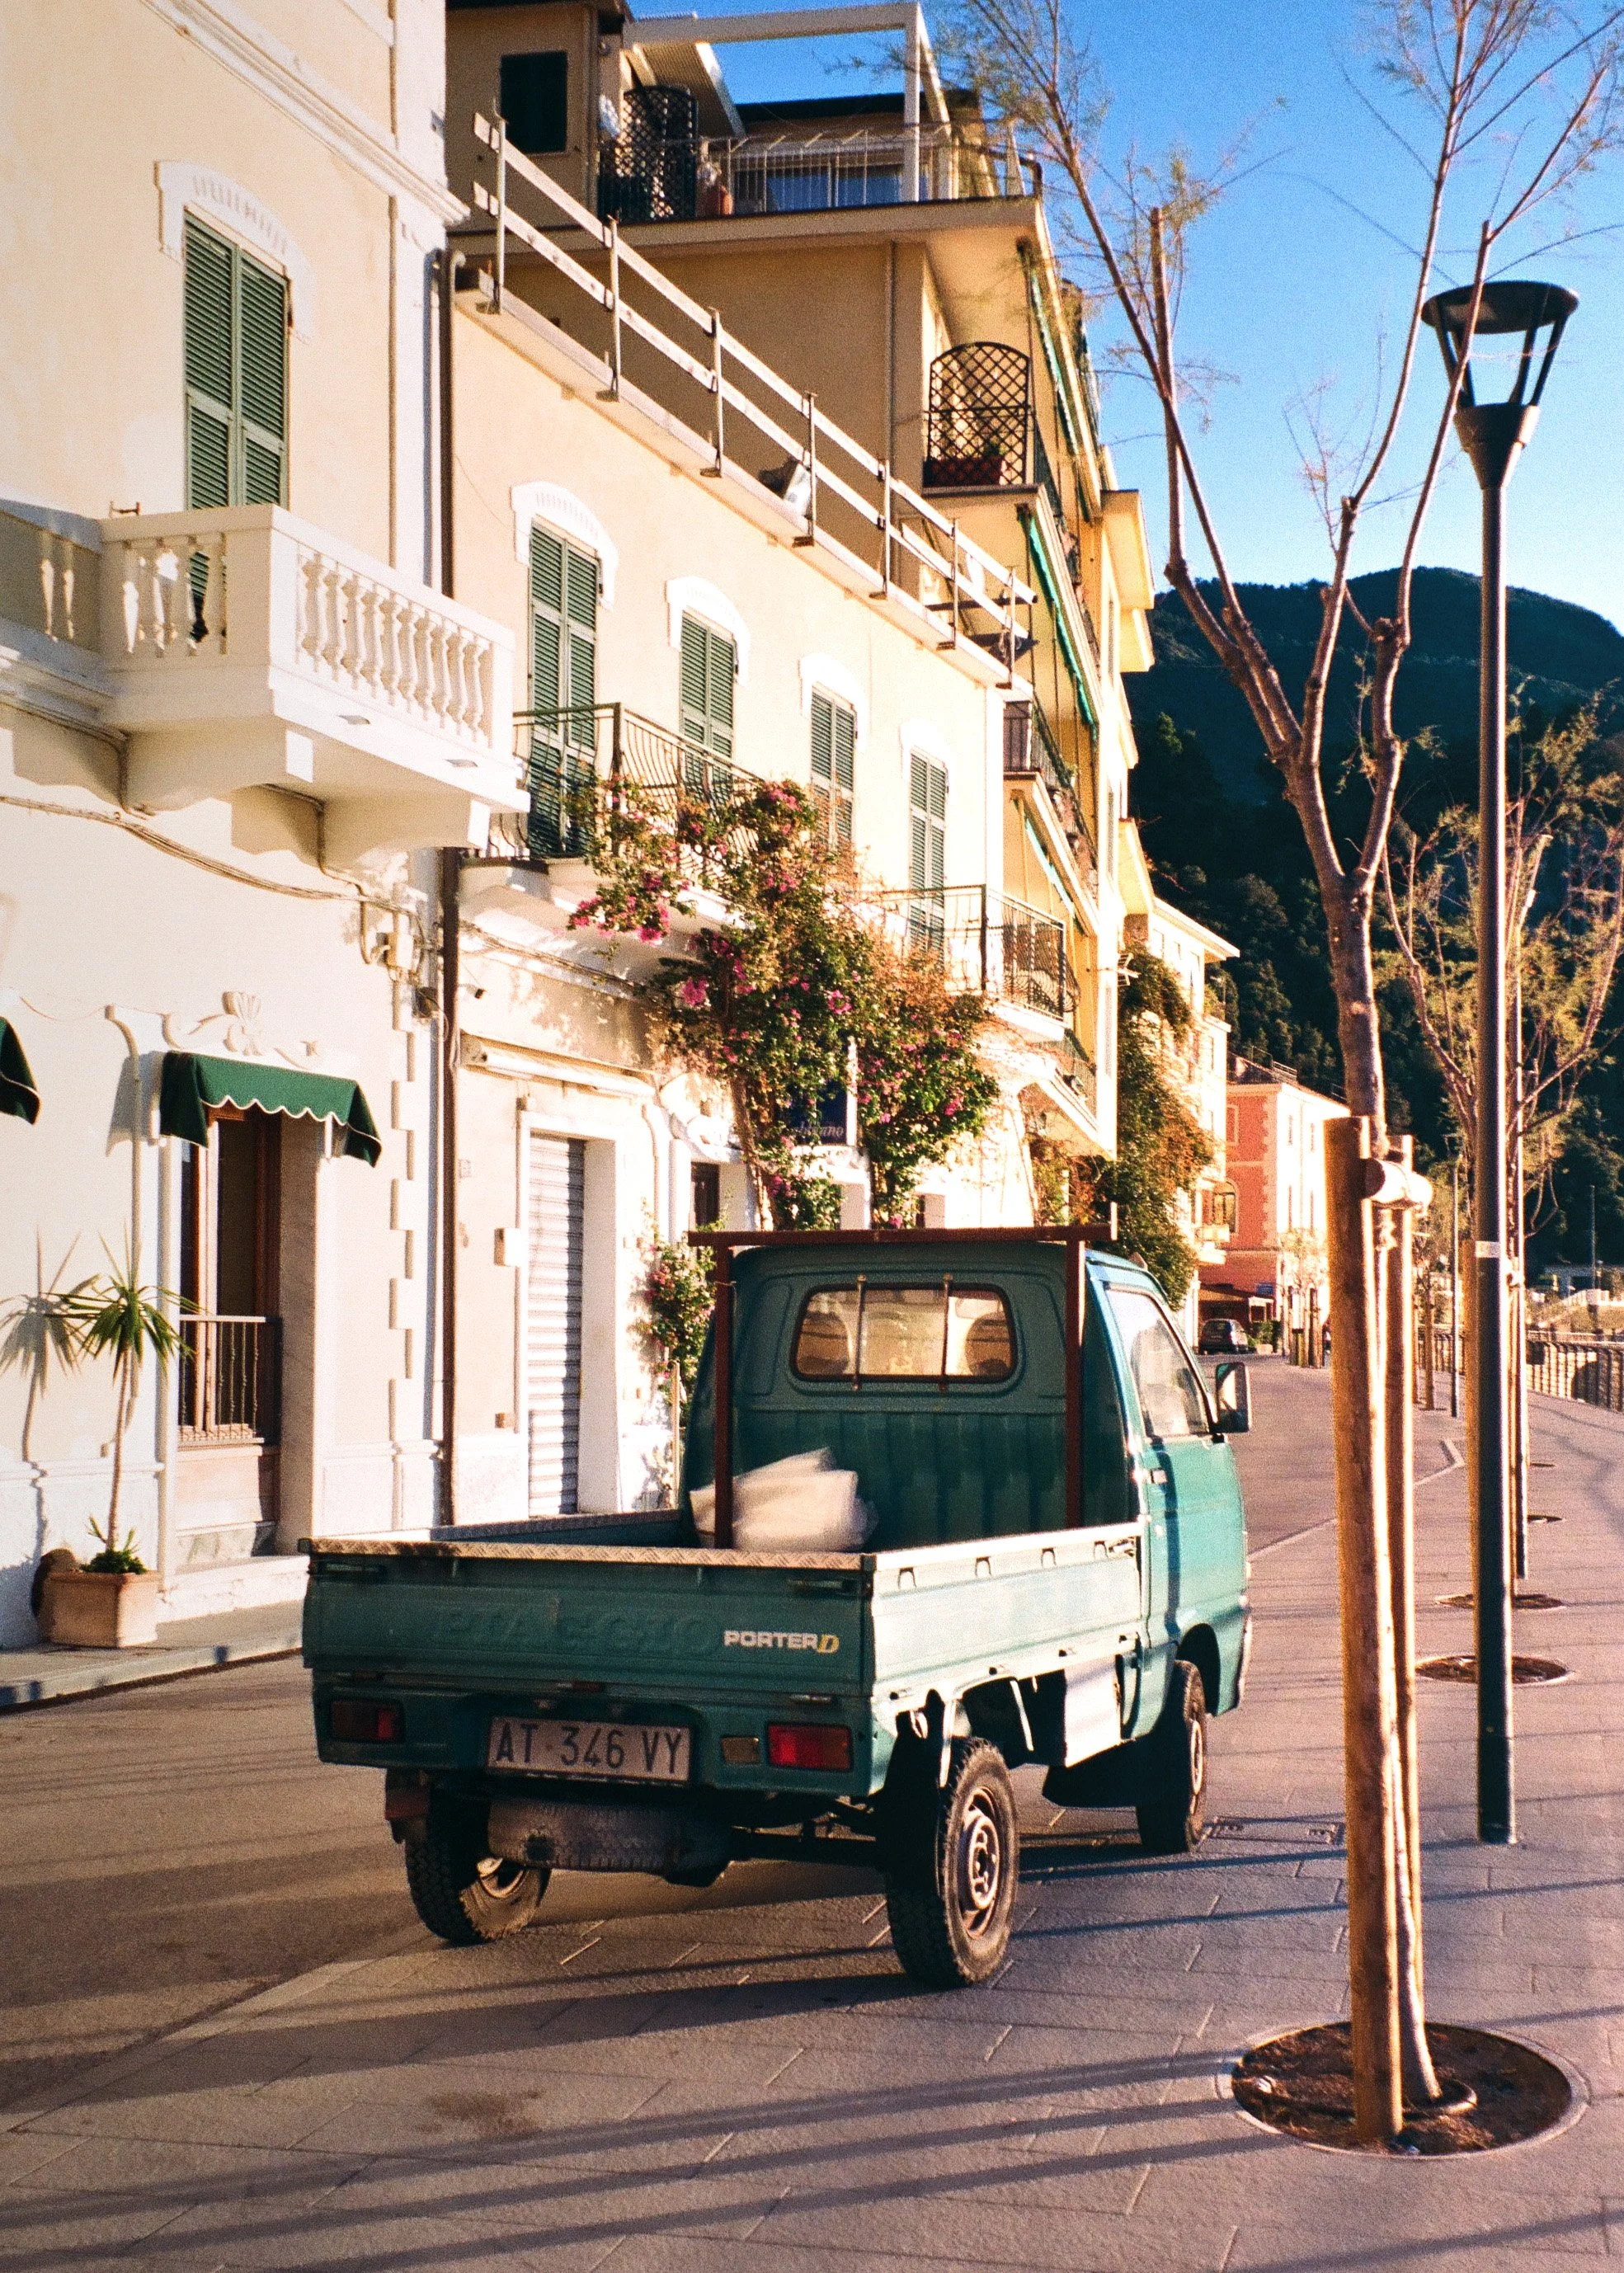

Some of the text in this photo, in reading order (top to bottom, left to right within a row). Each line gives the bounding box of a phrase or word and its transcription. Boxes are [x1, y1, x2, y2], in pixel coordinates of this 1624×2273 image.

[496, 1721, 682, 1774] AT 346 VY
